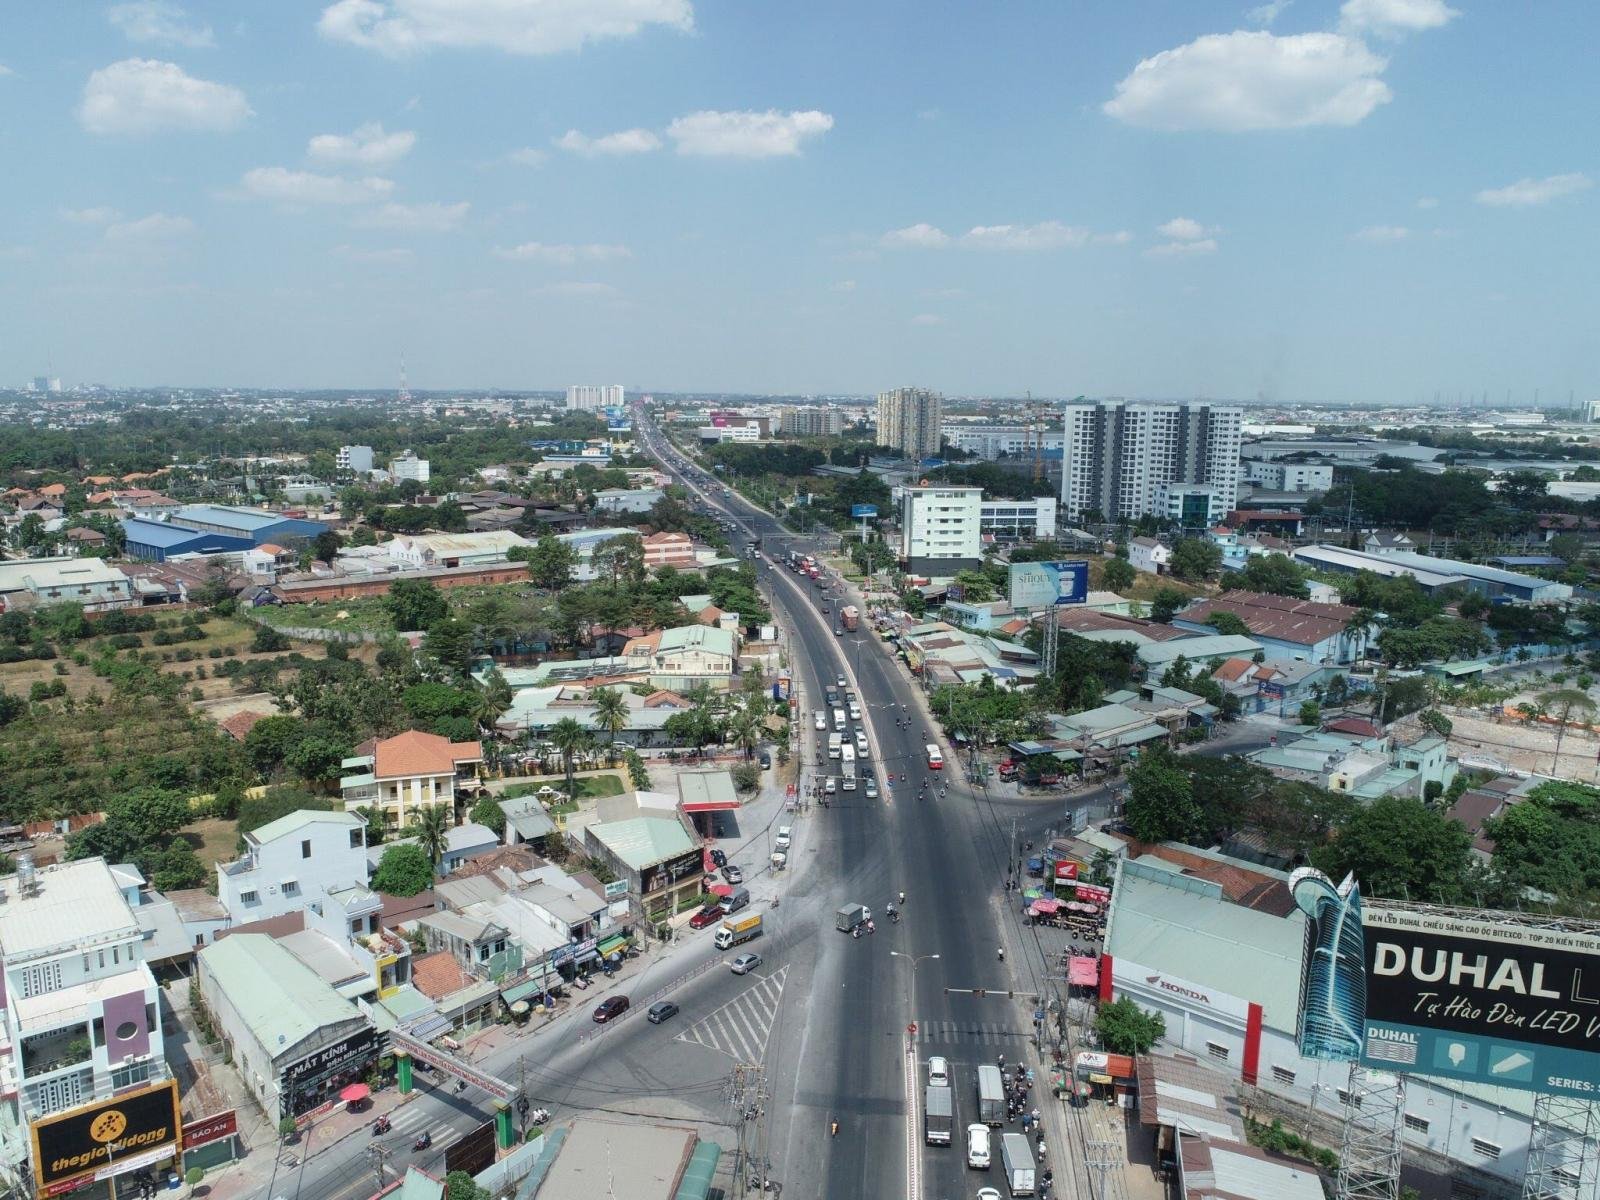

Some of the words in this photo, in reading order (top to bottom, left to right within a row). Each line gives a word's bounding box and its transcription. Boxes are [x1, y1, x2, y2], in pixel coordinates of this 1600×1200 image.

[1385, 916, 1397, 924] LED
[1400, 918, 1421, 928] DUHAL
[1466, 925, 1480, 935] CAO
[1493, 929, 1522, 940] BITEXCO
[1529, 933, 1543, 943] TOP
[1544, 936, 1554, 944] 20
[1373, 942, 1560, 999] DUHAL
[1160, 980, 1210, 1003] HONDA
[1414, 992, 1439, 1018] Tự
[1444, 995, 1481, 1019] Hào
[1486, 1002, 1527, 1027] Đèn
[1529, 1009, 1580, 1034] LED
[1586, 1015, 1600, 1038] V
[1368, 1027, 1418, 1044] DUHAL
[322, 1043, 348, 1062] KÍNH
[1547, 1076, 1594, 1092] SERIES:
[213, 1122, 227, 1132] AN
